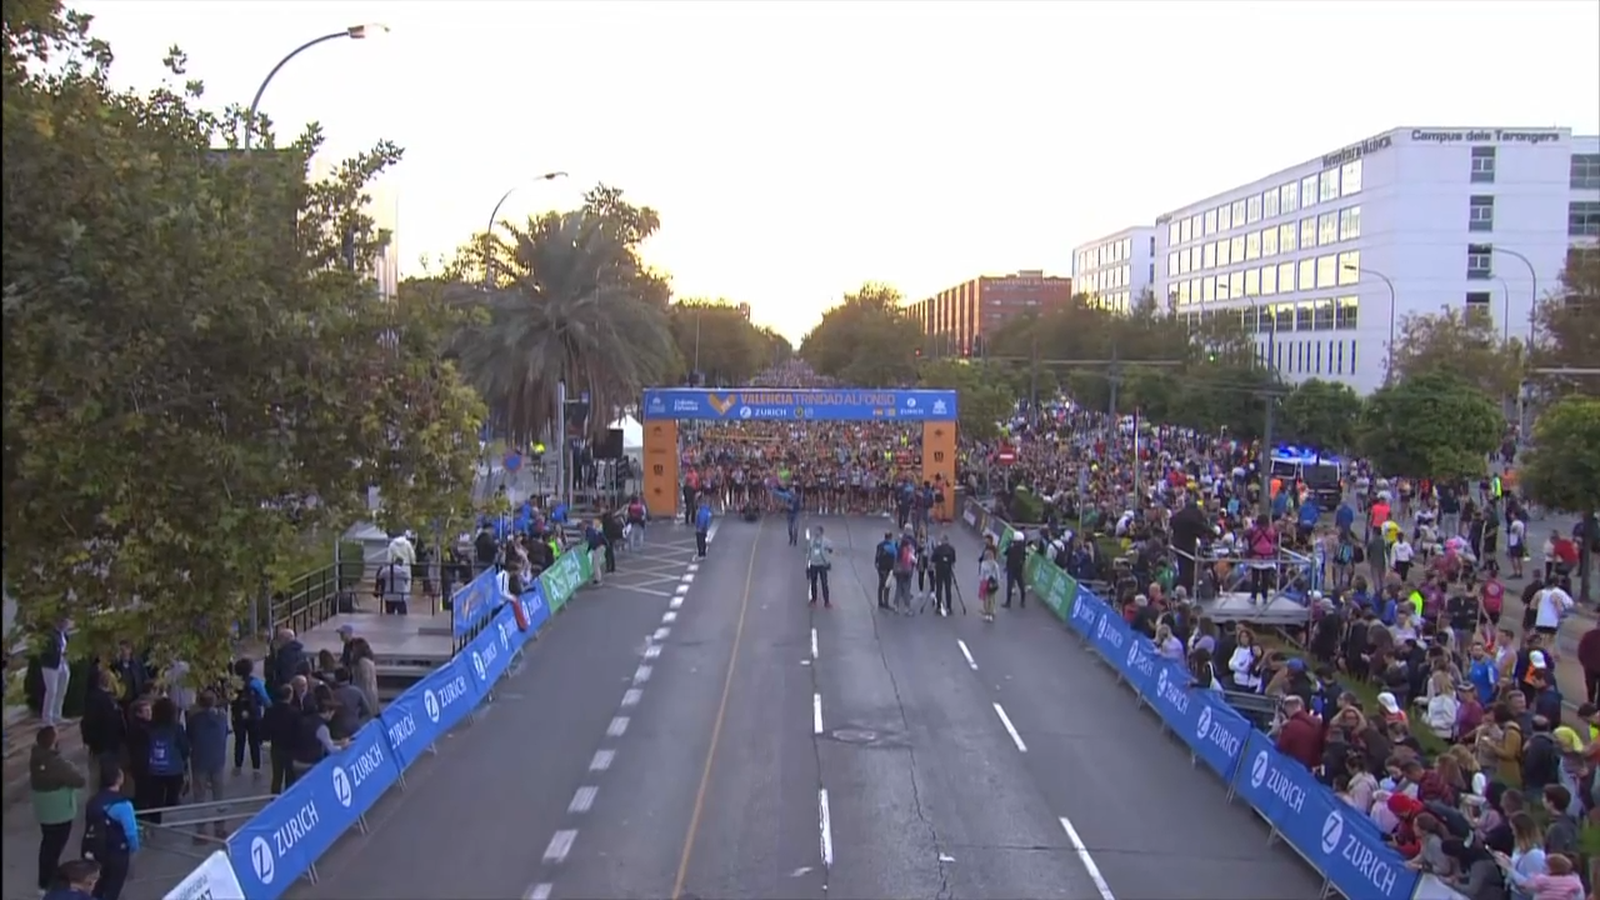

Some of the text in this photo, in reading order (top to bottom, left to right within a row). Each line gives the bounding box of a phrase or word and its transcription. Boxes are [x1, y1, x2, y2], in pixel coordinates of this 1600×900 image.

[1411, 129, 1560, 144] Campus dels Tarongers
[741, 393, 896, 405] VALENCIA TRINIDAD ALFONSO
[755, 407, 787, 416] ZURICH
[350, 742, 384, 788] ZURICH
[1267, 768, 1306, 813] ZURICH
[273, 801, 319, 857] ZURICH
[1342, 834, 1397, 896] ZURICH
